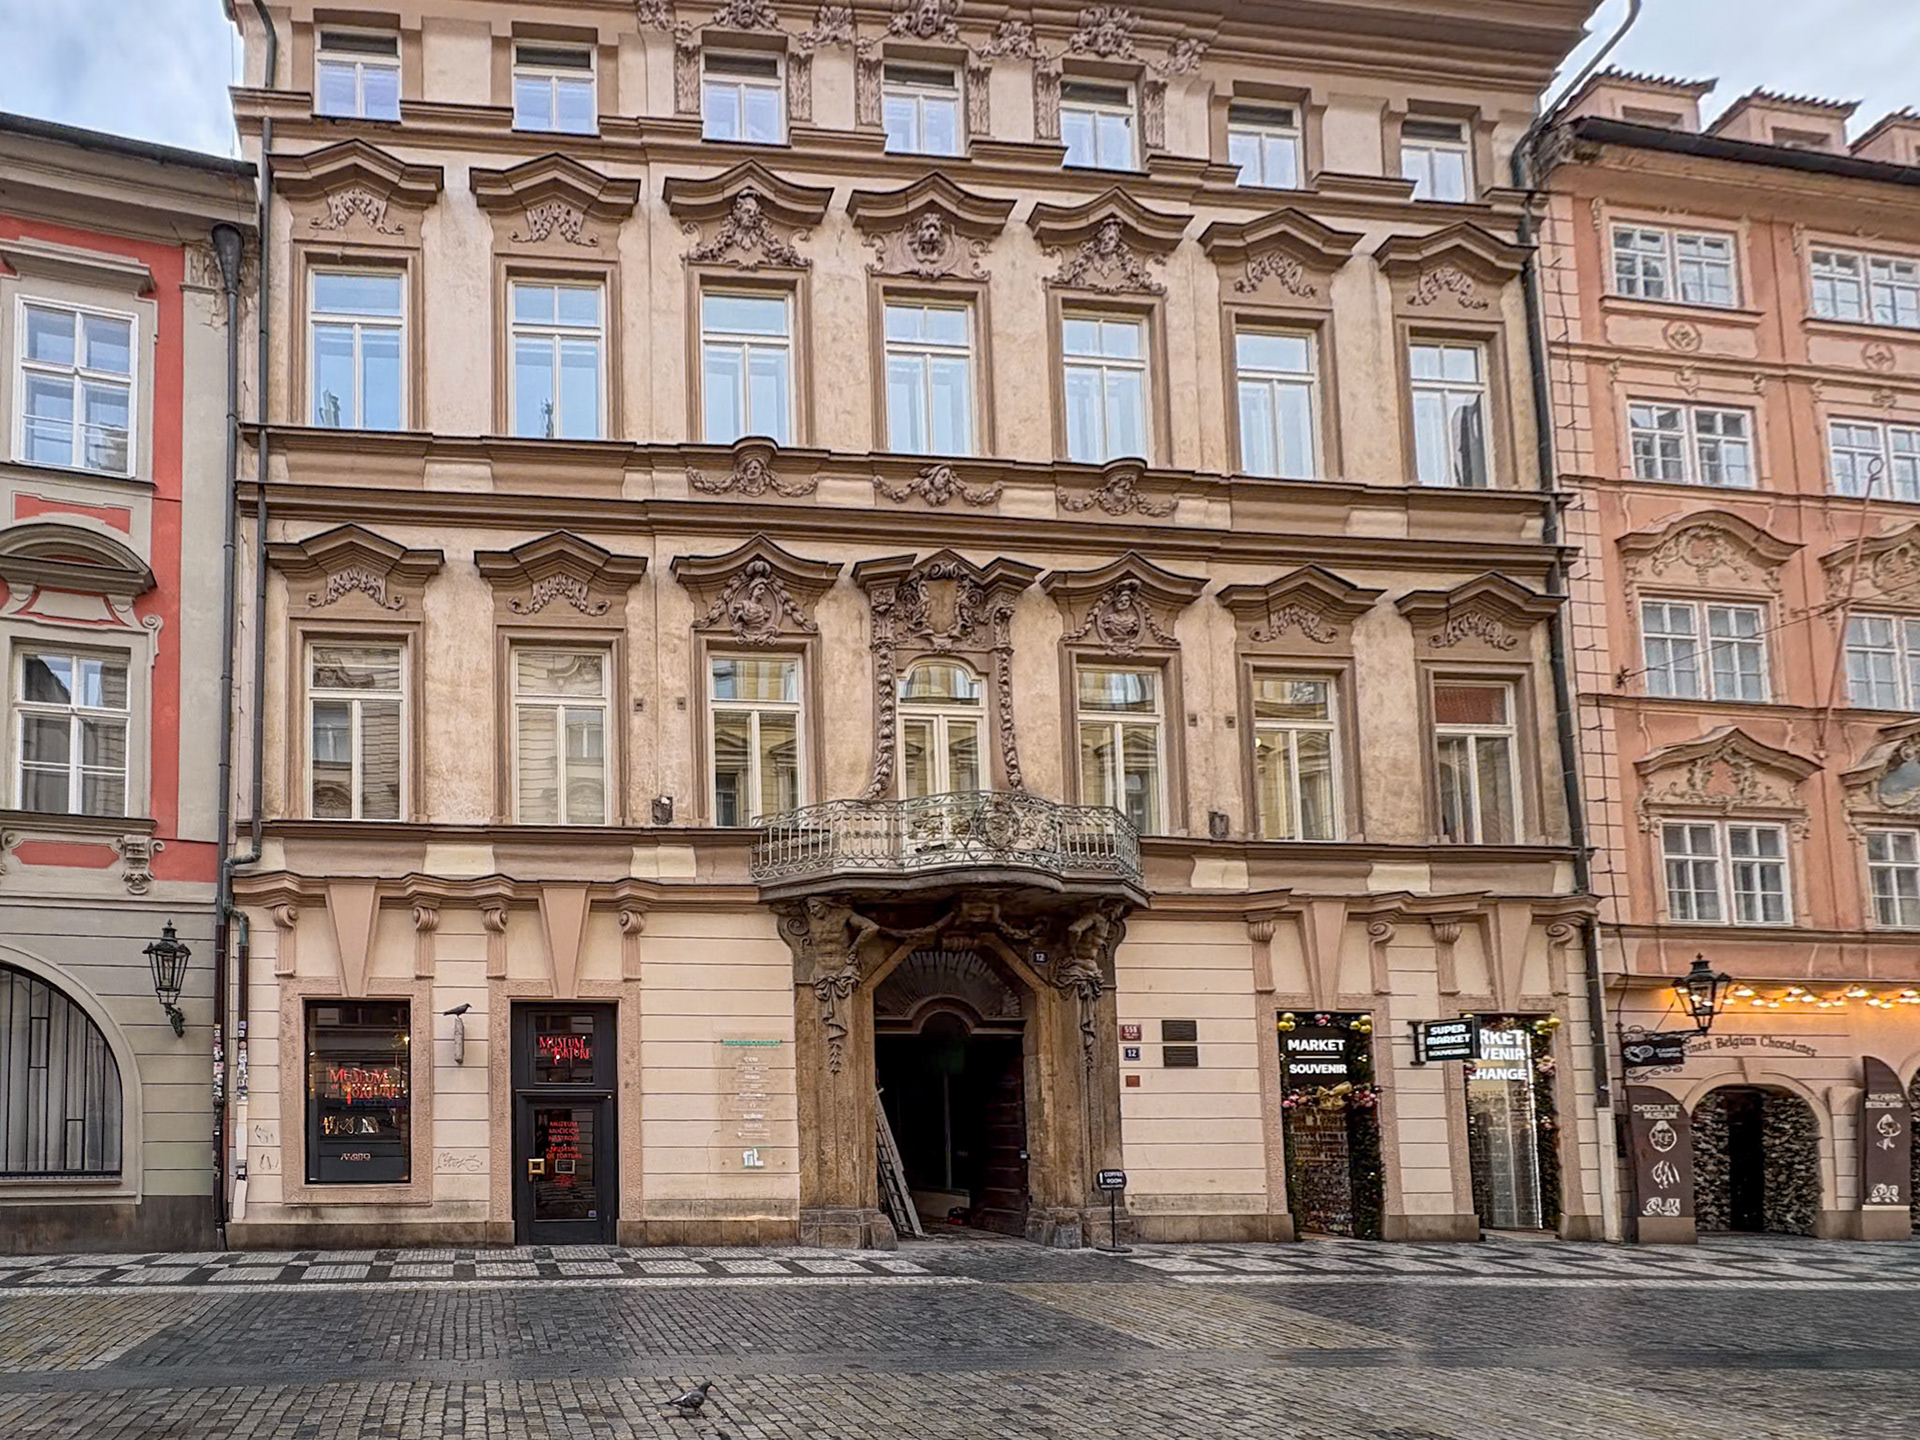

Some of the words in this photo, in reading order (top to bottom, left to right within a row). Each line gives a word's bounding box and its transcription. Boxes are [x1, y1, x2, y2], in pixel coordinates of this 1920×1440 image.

[1035, 953, 1046, 961] 12
[1430, 1024, 1466, 1035] SUPER
[539, 1036, 585, 1048] MUSEUM
[1426, 1033, 1471, 1045] MARKET
[1480, 1029, 1525, 1045] RKET
[1287, 1039, 1346, 1051] MARKET
[1715, 1035, 1757, 1049] Belgian
[1760, 1034, 1818, 1057] Chocolates
[1127, 1049, 1137, 1057] 12
[1480, 1047, 1526, 1060] VENIR
[1289, 1063, 1348, 1074] SOUVENIR
[329, 1067, 388, 1083] MUSEUM
[1632, 1103, 1680, 1112] CHOCOLATE
